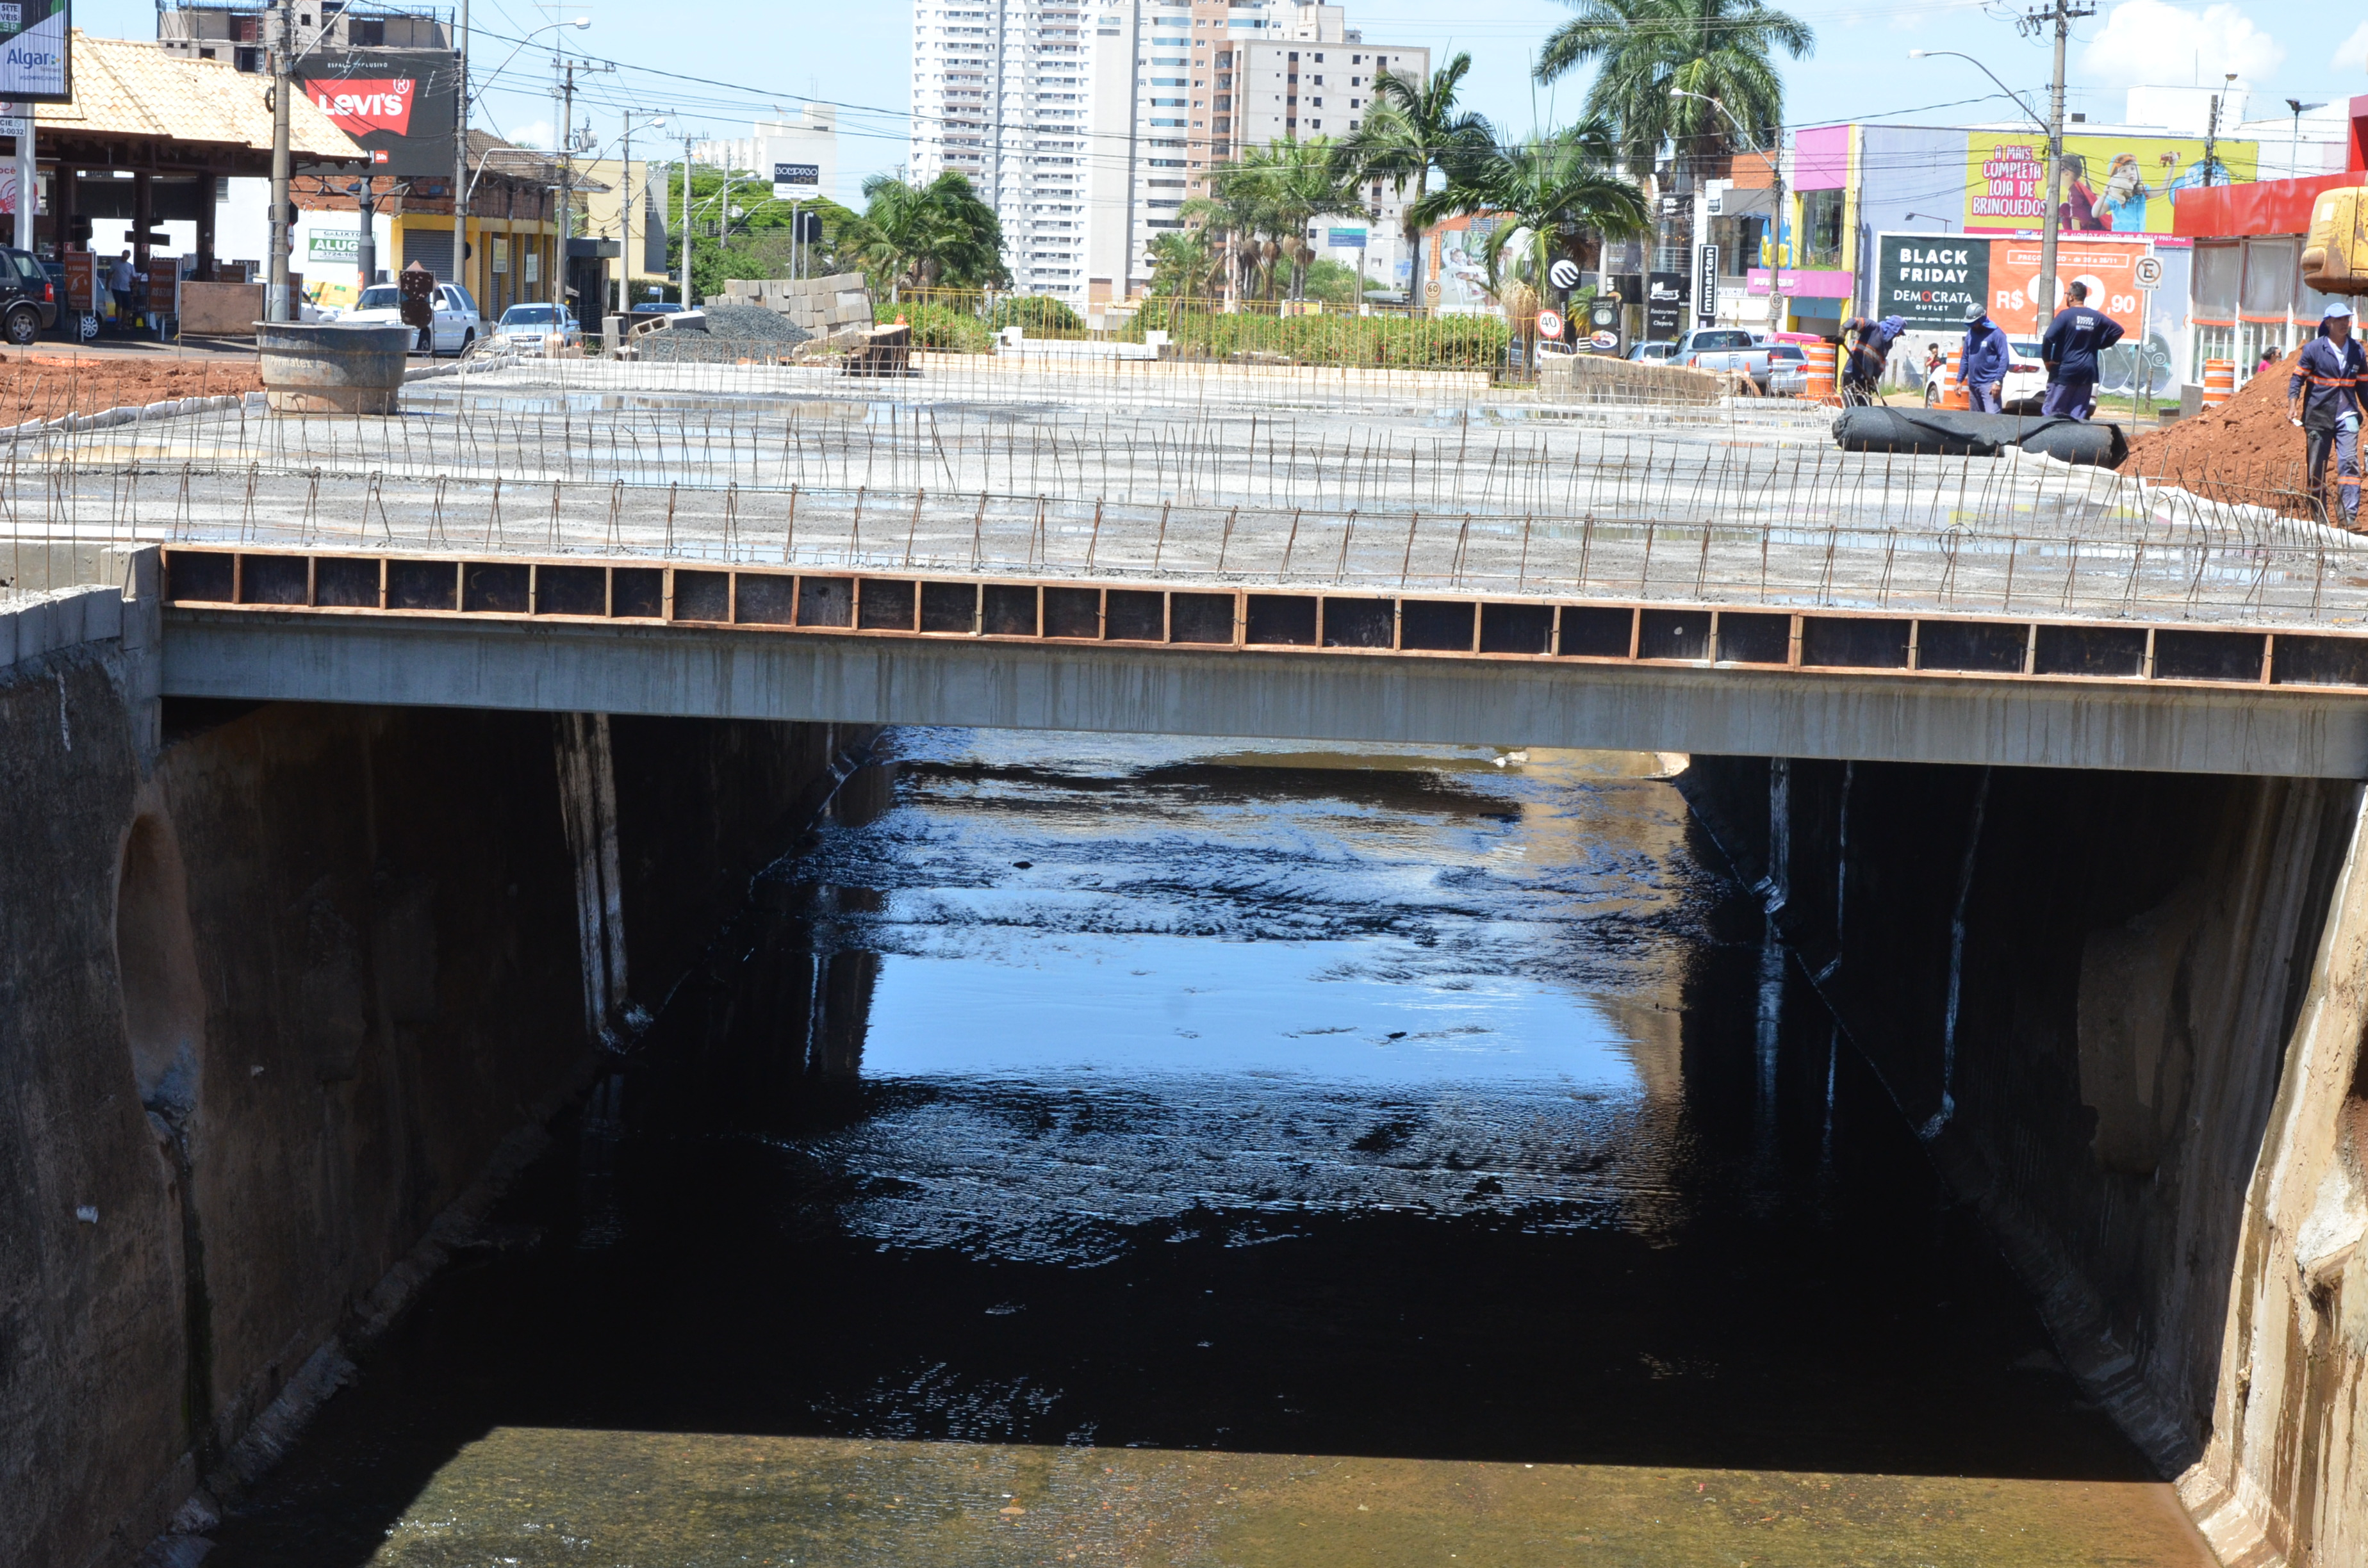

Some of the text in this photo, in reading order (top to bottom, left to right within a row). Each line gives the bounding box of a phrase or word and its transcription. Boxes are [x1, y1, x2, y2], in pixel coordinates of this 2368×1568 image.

[7, 47, 49, 69] Algar
[1995, 146, 2032, 159] A MAIS
[775, 167, 818, 176] BOMPISO
[1984, 161, 2041, 179] COMPLETA
[794, 176, 817, 184] HOME
[1989, 180, 2034, 197] LOJA DE
[1973, 197, 2046, 216] BRINQUEDOS
[314, 239, 359, 252] ALUG
[1900, 248, 1968, 265] BLACK
[1704, 249, 1714, 312] mmartan
[1900, 268, 1968, 283] FRIDAY
[1893, 290, 1973, 304] DEMOCRATA
[1996, 289, 2024, 311] R$
[1542, 316, 1557, 327] 40
[270, 355, 313, 369] Permatex
